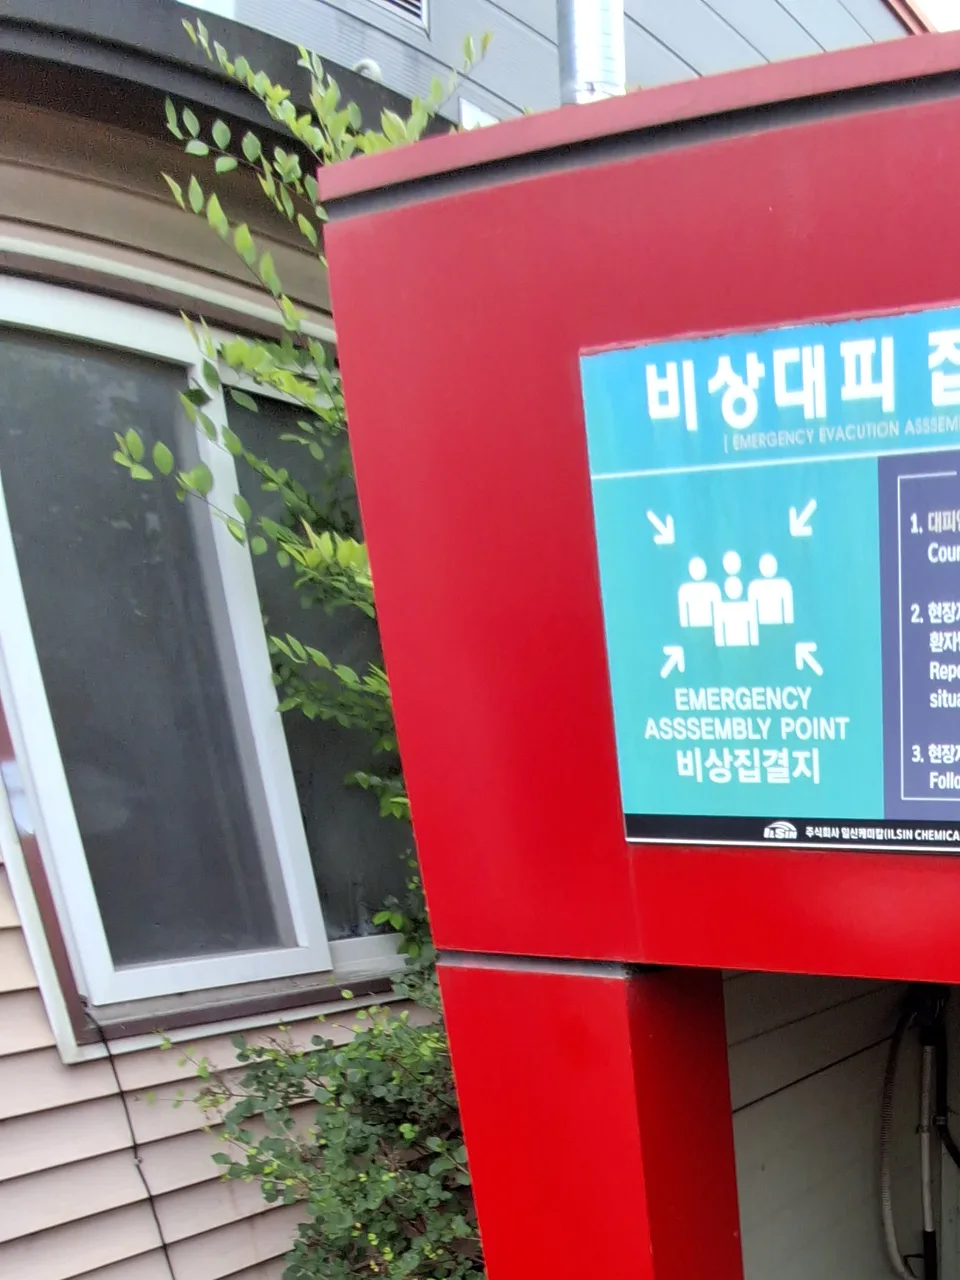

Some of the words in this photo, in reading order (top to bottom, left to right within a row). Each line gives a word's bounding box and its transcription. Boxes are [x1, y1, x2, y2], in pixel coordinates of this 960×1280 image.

[643, 337, 897, 431] 비상대피
[732, 428, 814, 451] EMERGENCY
[818, 421, 899, 444] EVACUTION
[910, 512, 923, 534] 1.
[910, 603, 924, 623] 2.
[674, 686, 812, 711] EMERGENCY
[644, 717, 771, 740] ASSSEMBLY
[780, 716, 850, 740] POINT
[676, 747, 820, 784] 비상집결지
[911, 744, 924, 763] 3.
[805, 825, 840, 839] 주식회사
